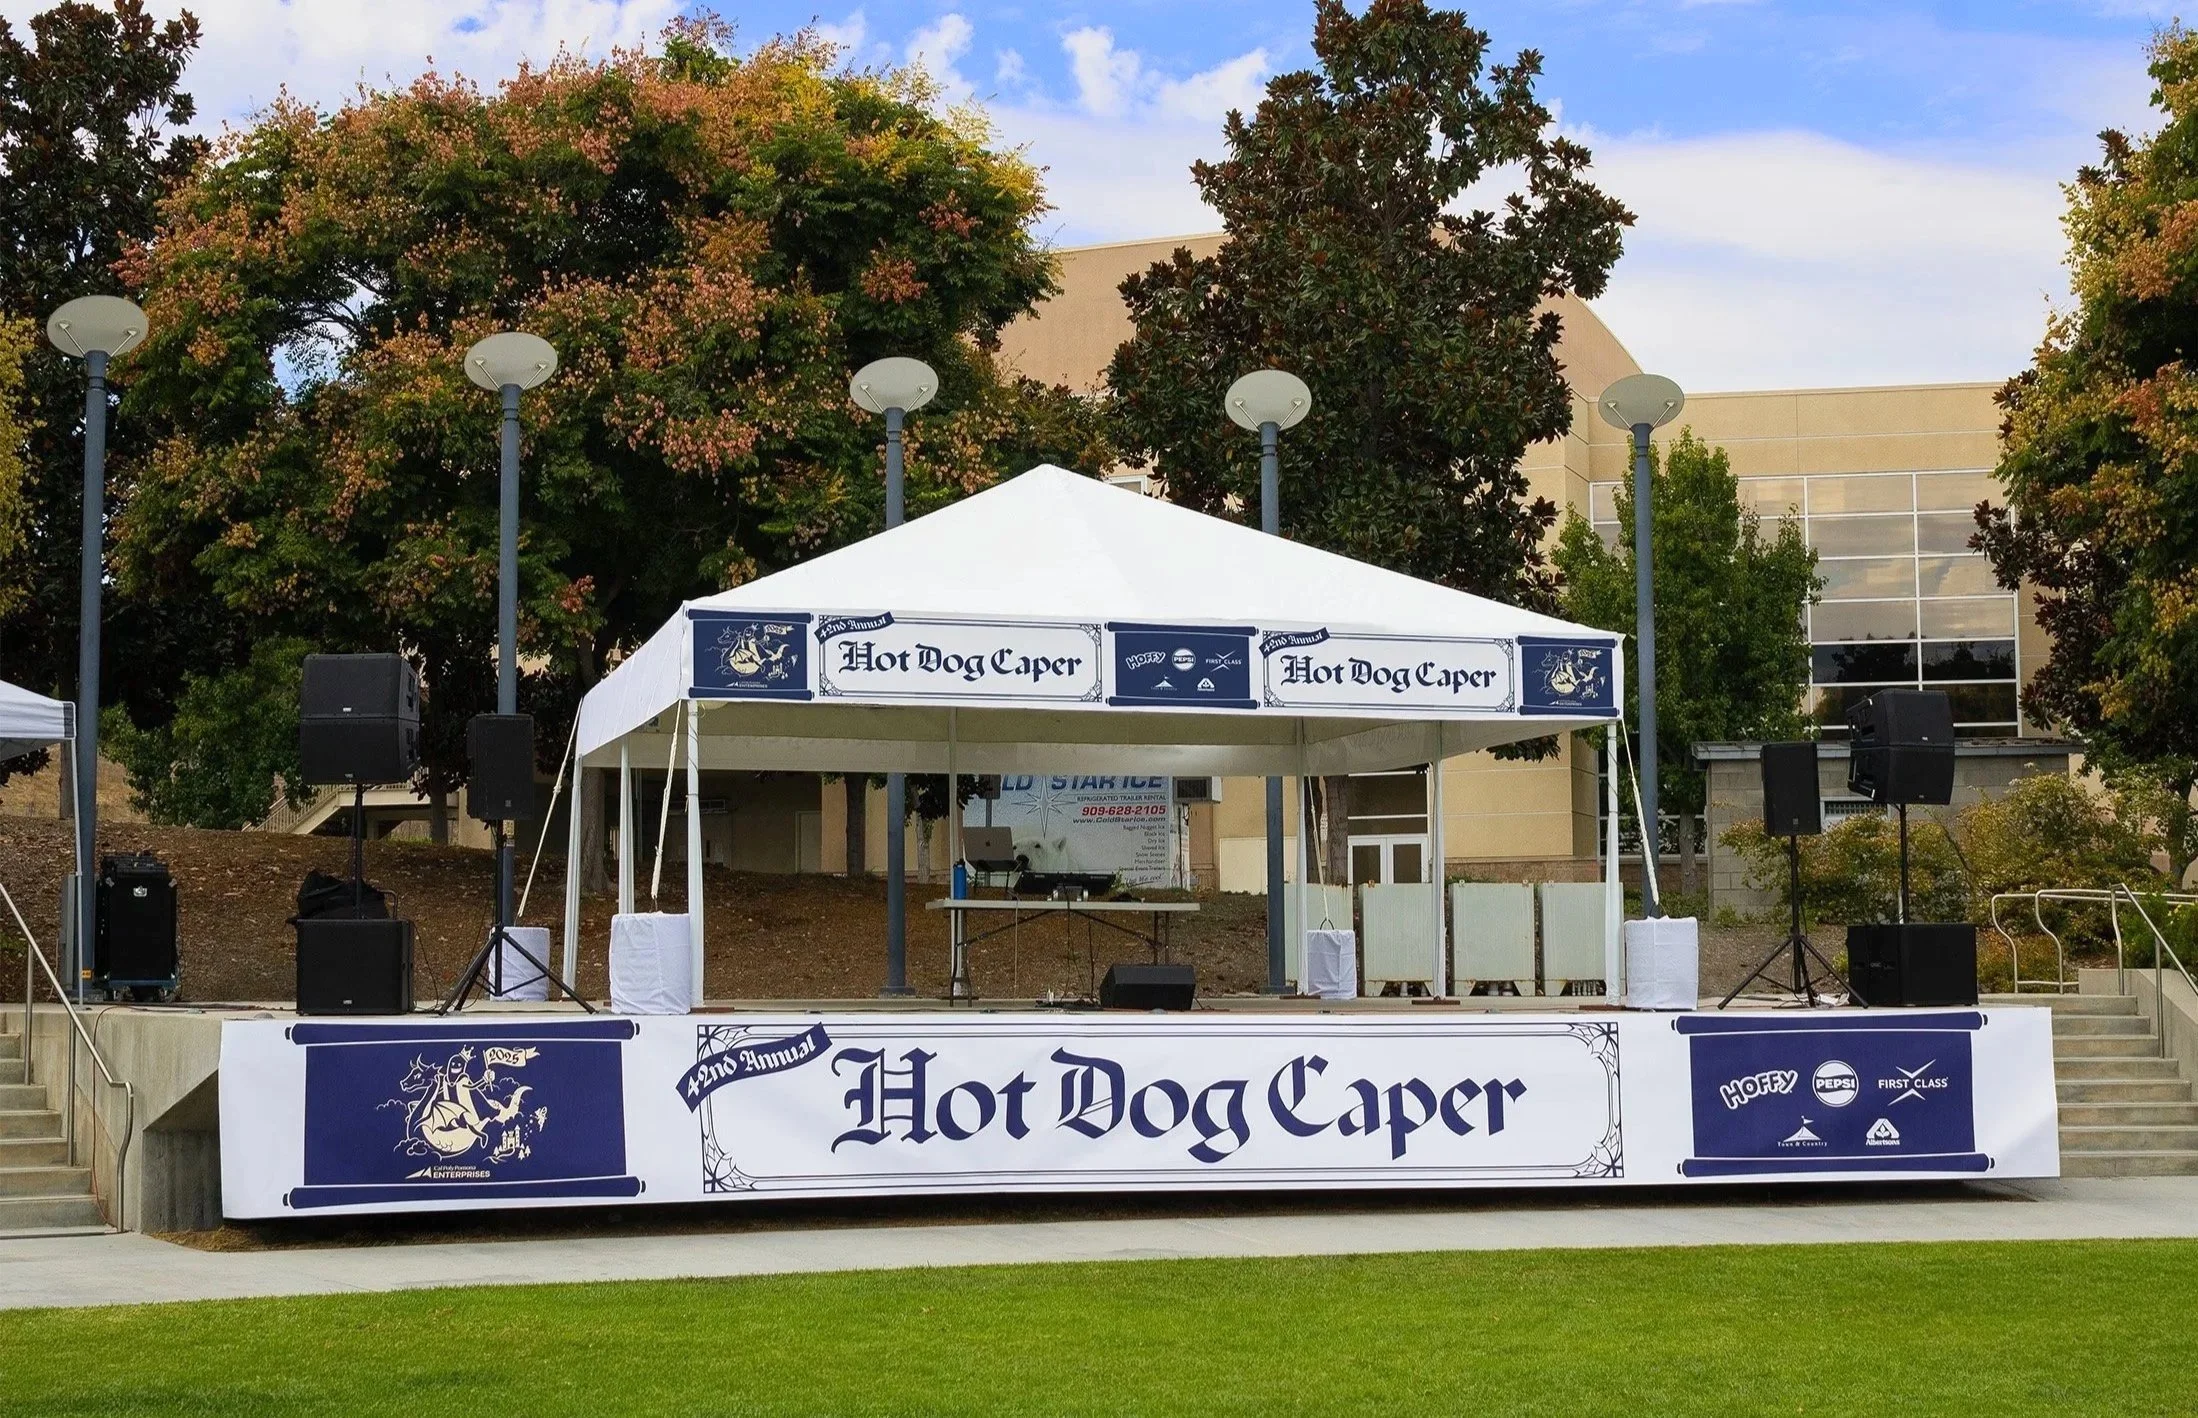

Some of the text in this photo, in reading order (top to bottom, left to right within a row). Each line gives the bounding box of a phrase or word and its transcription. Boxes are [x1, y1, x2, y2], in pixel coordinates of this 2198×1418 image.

[820, 616, 887, 639] 42nd Annual
[1263, 632, 1323, 652] 42nd Annual
[838, 640, 1082, 683] Hot Dog Caper
[1125, 651, 1166, 670] HOFFY
[1280, 655, 1497, 694] Hot Dog Caper
[1002, 775, 1163, 791] LD STAR ICE
[489, 1049, 519, 1065] 2025
[687, 1034, 816, 1098] 42nd Annual
[1719, 1069, 1798, 1110] HOFFY
[1815, 1077, 1856, 1090] PEPSI
[1878, 1077, 1948, 1089] FIRST CLASS
[830, 1046, 1528, 1164] Hot Dog Caper
[1865, 1138, 1900, 1146] Albertsons
[433, 1170, 491, 1179] ENTERPRISES
